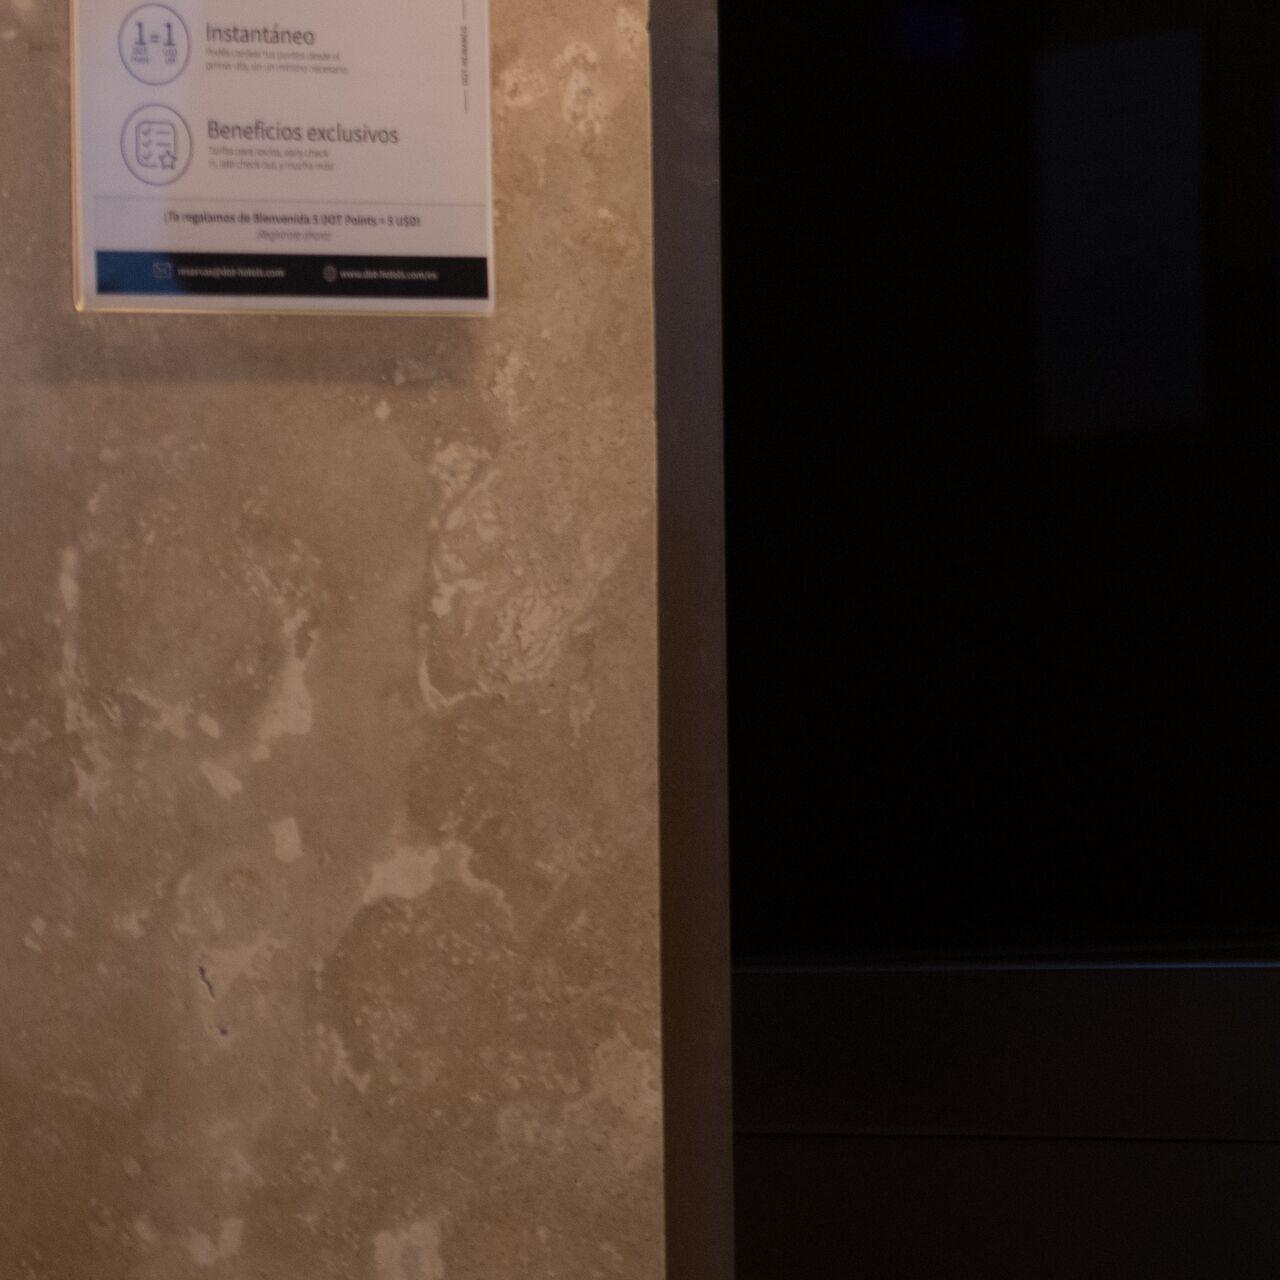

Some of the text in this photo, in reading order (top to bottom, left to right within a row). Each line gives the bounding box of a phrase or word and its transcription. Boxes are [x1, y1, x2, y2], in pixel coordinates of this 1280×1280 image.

[206, 22, 315, 46] Instantáneo
[207, 120, 400, 144] Beneficios exclusivos
